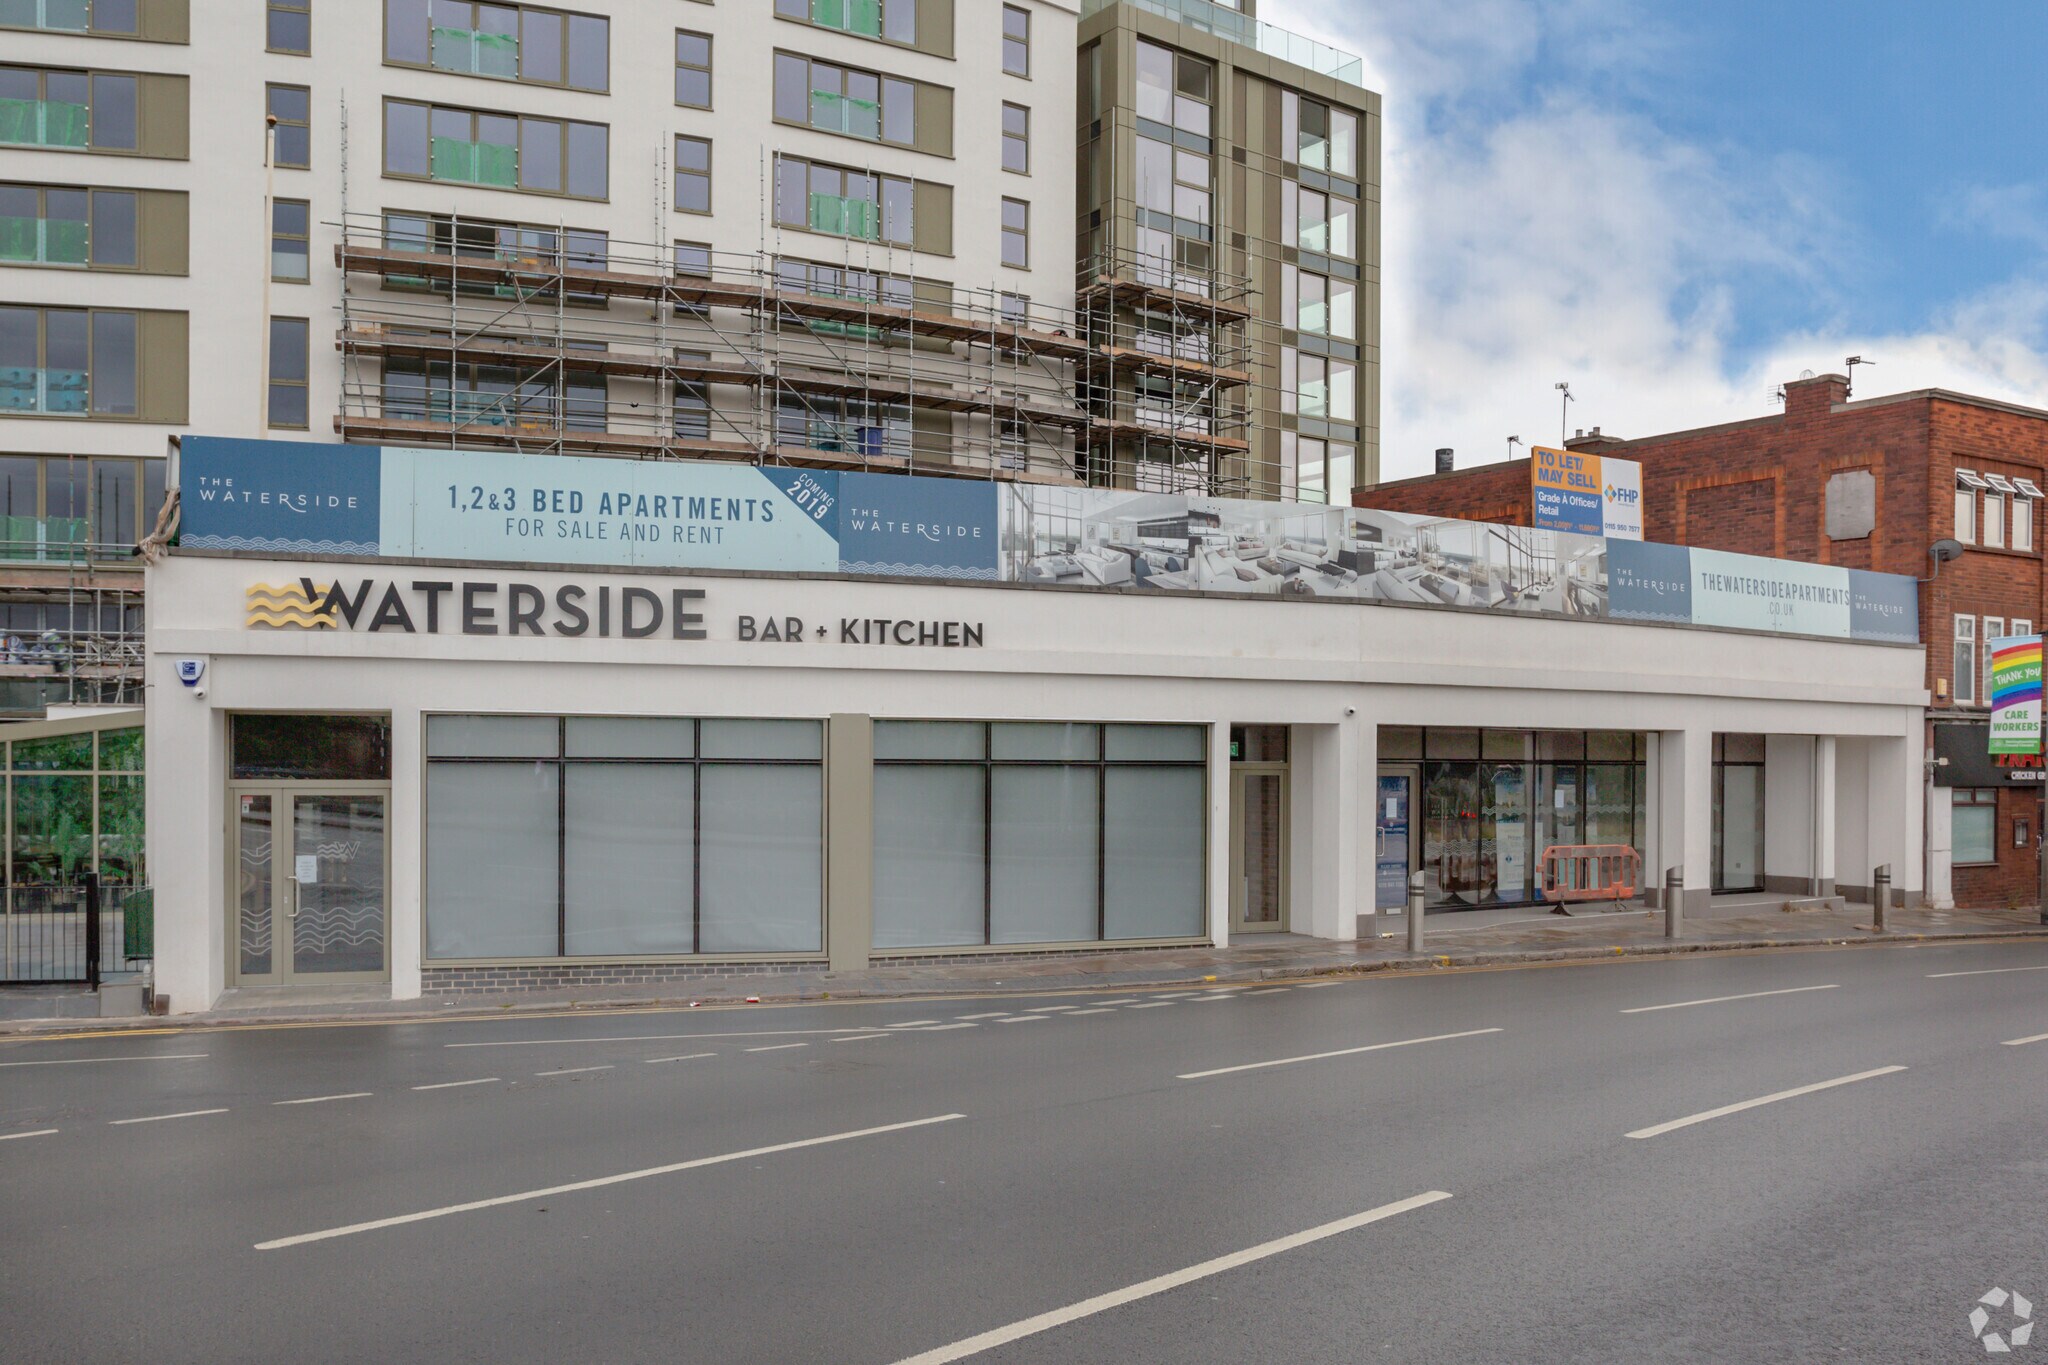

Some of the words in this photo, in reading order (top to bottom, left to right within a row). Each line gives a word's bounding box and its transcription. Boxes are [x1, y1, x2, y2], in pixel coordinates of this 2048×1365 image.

[1538, 451, 1555, 467] TO
[1558, 455, 1584, 471] LET/
[199, 477, 233, 487] THE
[1538, 467, 1564, 484] MAY
[1567, 472, 1596, 489] SELL
[799, 473, 835, 508] COMING
[1617, 488, 1639, 503] FHP
[199, 489, 357, 512] WATERSIDE
[448, 485, 516, 513] 1,2&3
[532, 489, 584, 514] BED
[599, 492, 774, 522] APARTMENTS
[786, 481, 828, 519] 2019
[1538, 492, 1561, 503] Grade
[1569, 497, 1599, 509] Offices/
[851, 508, 879, 518] THE
[1538, 504, 1559, 516] Retail
[506, 518, 544, 538] FOR
[557, 520, 608, 540] SALE
[620, 523, 660, 542] AND
[673, 525, 725, 544] RENT
[851, 519, 981, 542] WATERSIDE
[1616, 568, 1632, 576] THE
[1616, 576, 1686, 595] WATERSIDE
[1701, 572, 1850, 606] THEWATERSIDEAPARTMENTS
[299, 577, 708, 640] WATERSIDE
[738, 615, 804, 643] BAR
[841, 618, 984, 648] KITCHEN
[1766, 601, 1794, 616] .CO.UK
[1855, 603, 1904, 617] WATERSIDE
[1994, 670, 2023, 685] THANK
[2025, 667, 2041, 678] YOU
[2004, 710, 2029, 719] CARE
[1993, 722, 2039, 732] WORKERS
